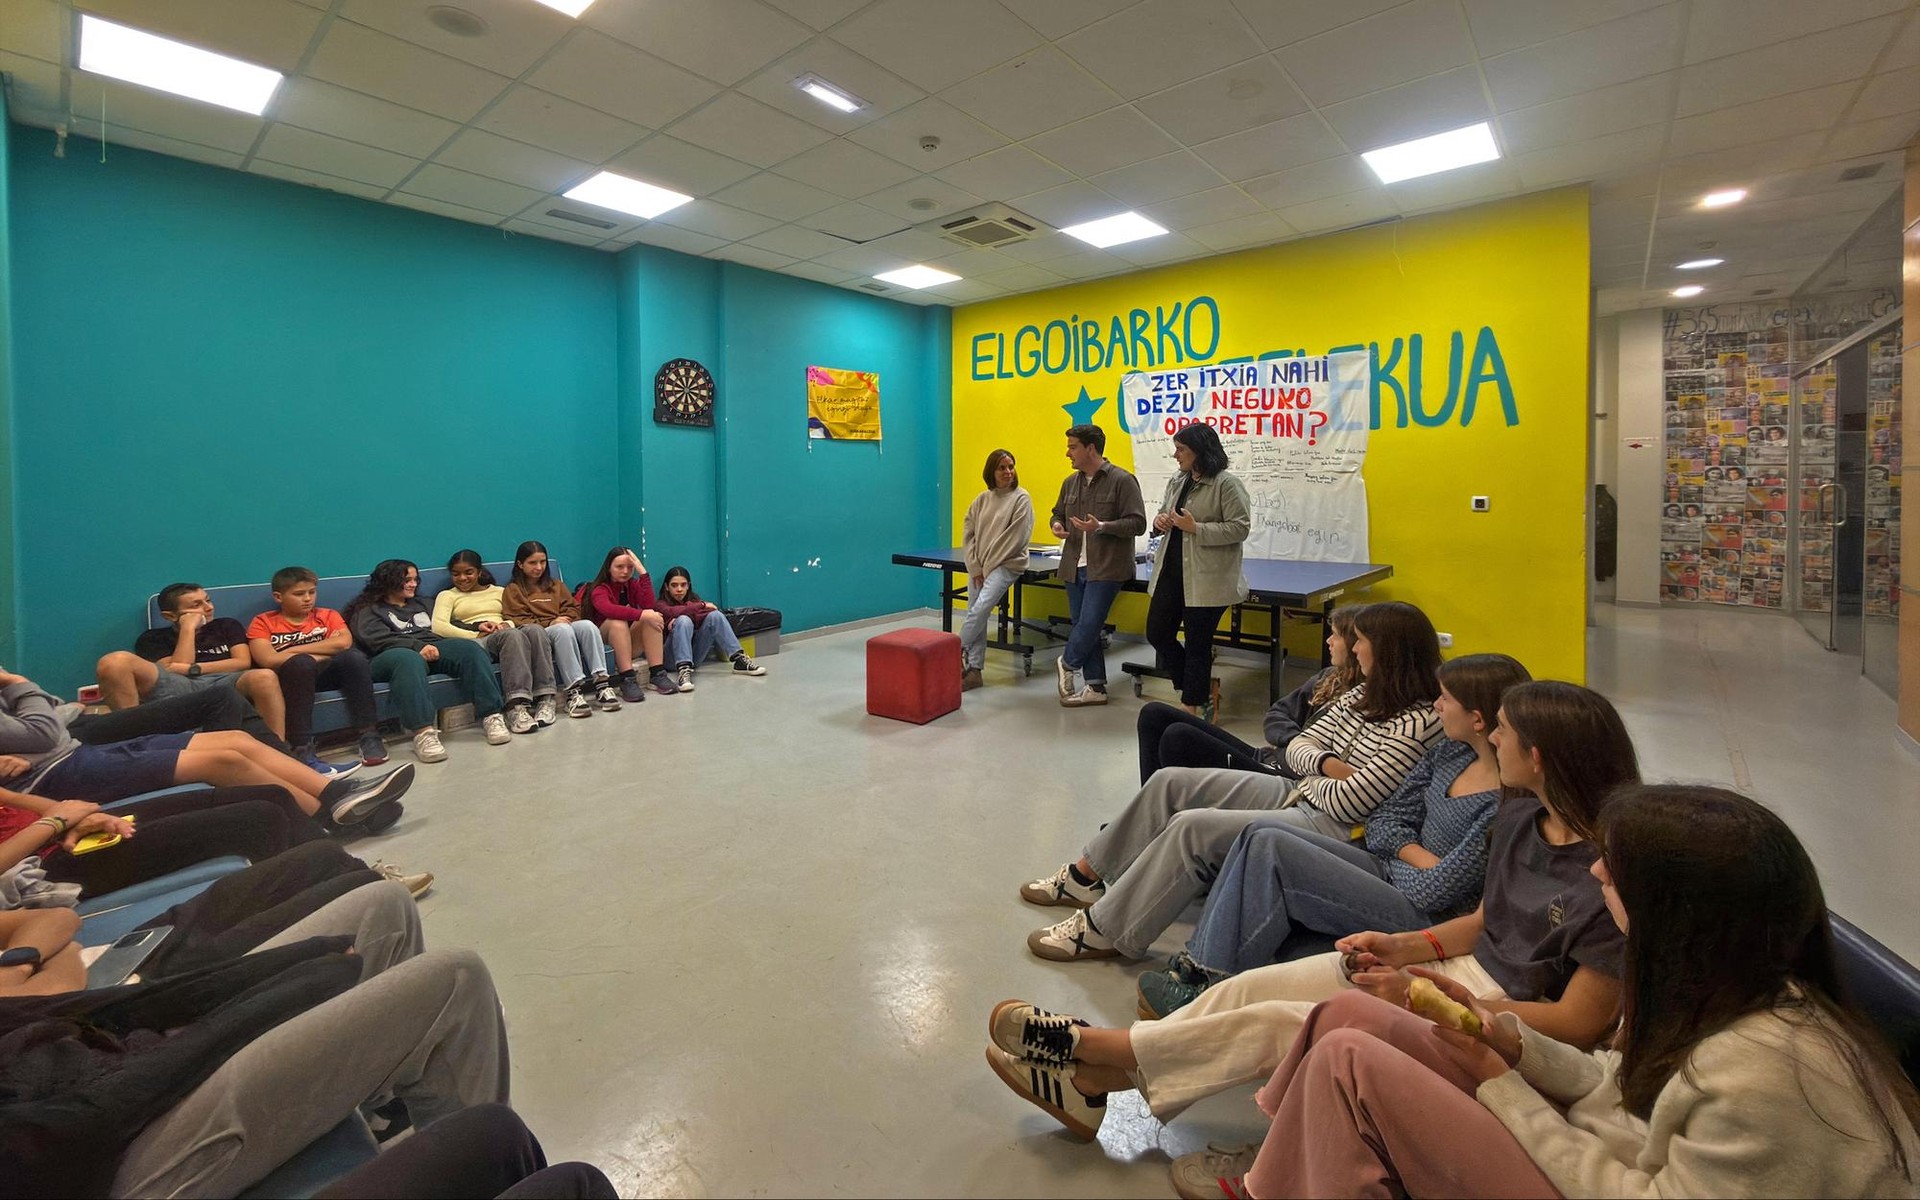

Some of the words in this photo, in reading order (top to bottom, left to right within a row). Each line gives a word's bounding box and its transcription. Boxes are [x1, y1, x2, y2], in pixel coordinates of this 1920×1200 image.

[1150, 372, 1189, 392] ZER
[1137, 391, 1195, 416] DEZU
[1212, 387, 1312, 411] NEGUKO
